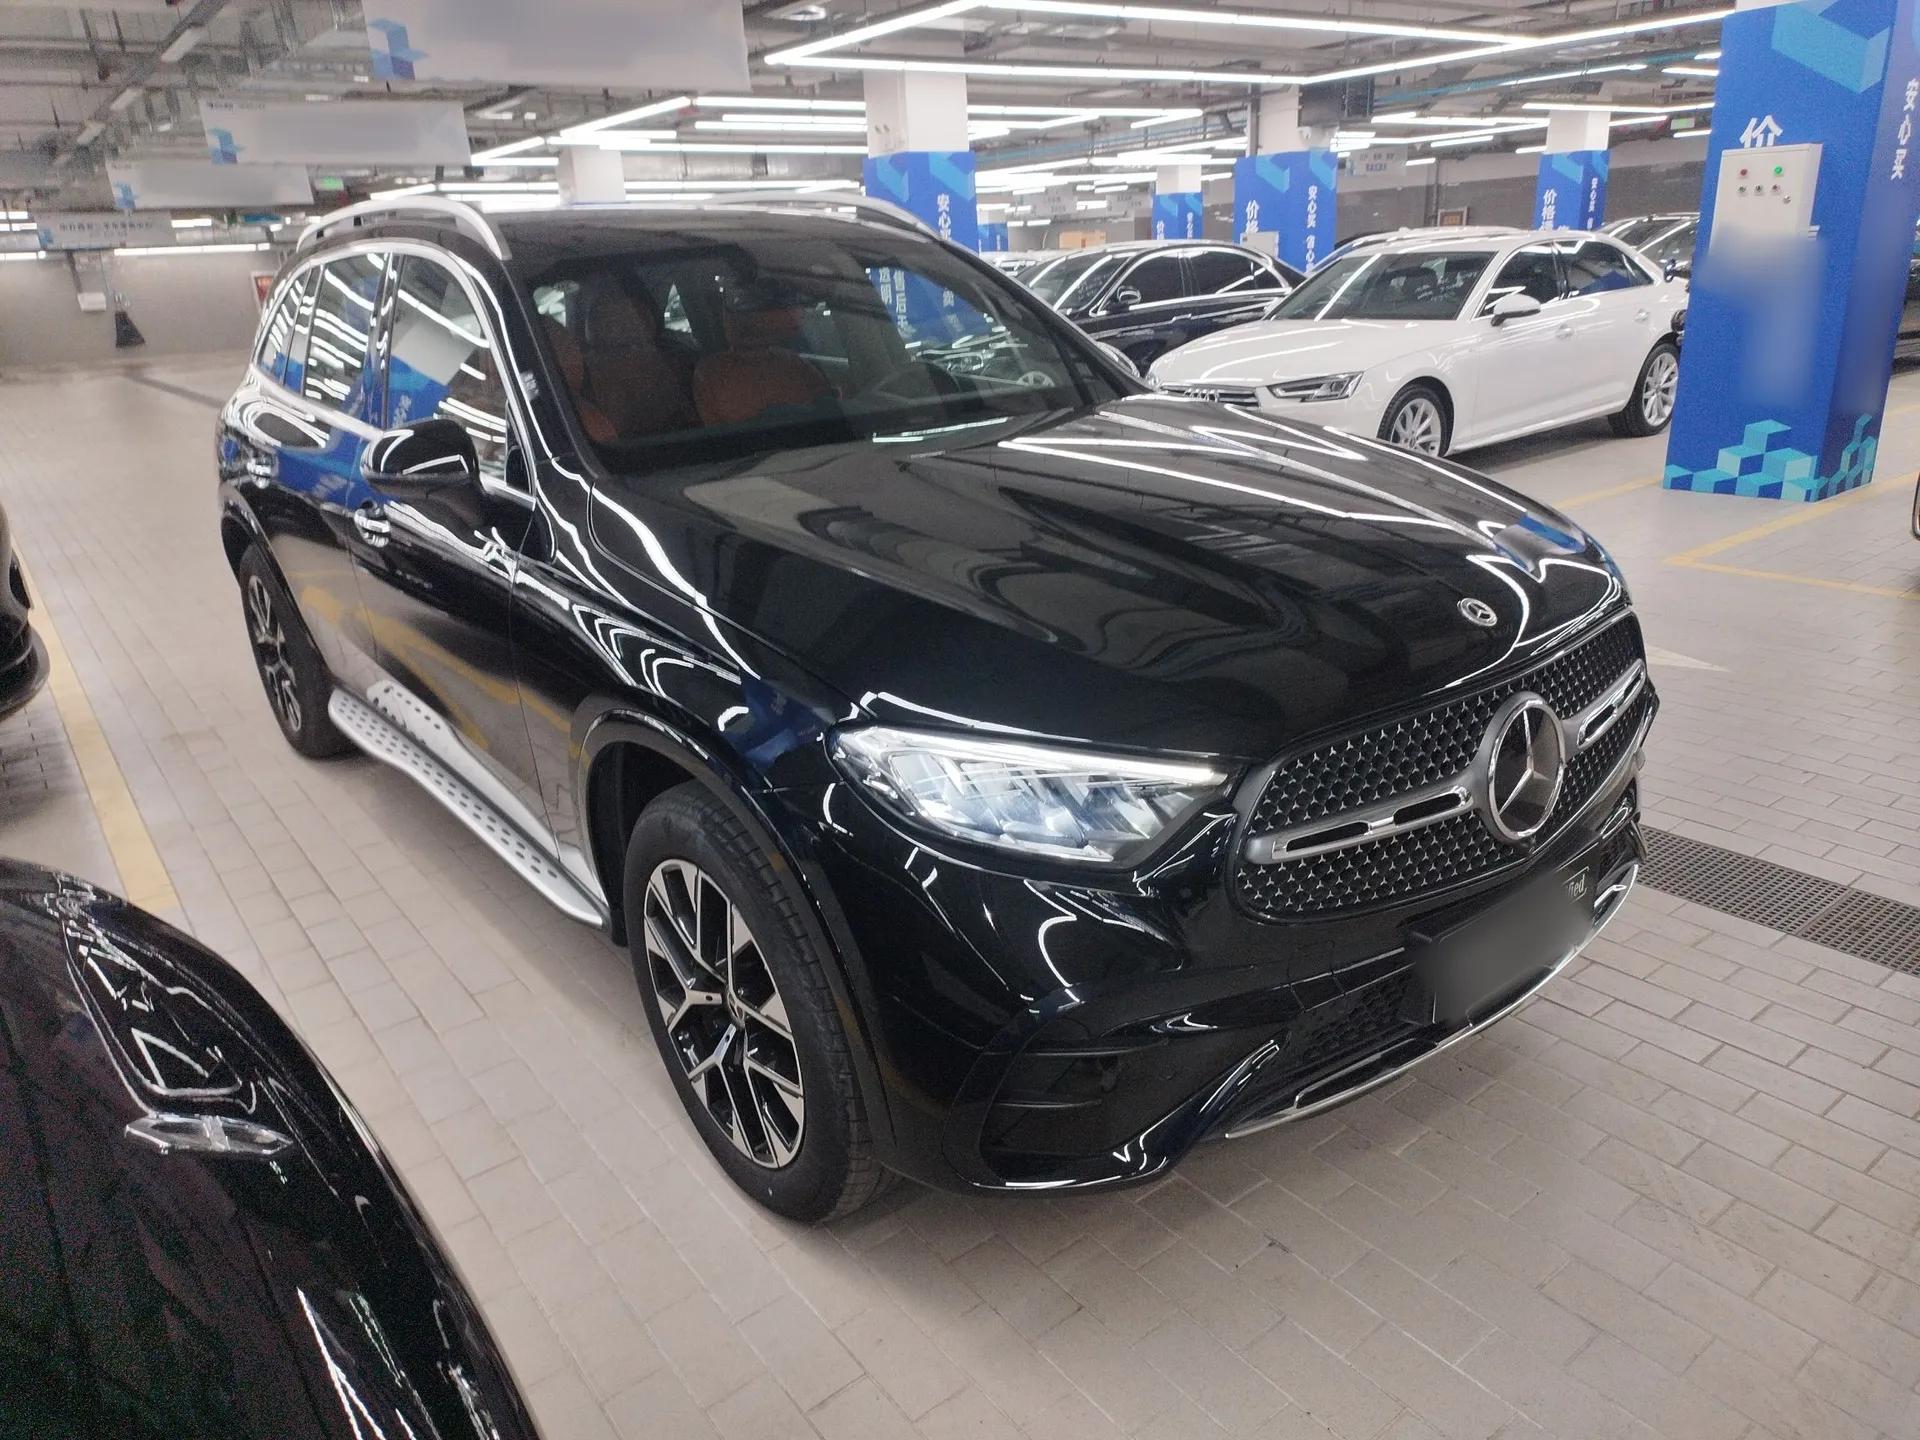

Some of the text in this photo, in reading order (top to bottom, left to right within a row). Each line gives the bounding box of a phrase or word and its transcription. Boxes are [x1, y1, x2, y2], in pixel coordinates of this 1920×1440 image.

[1740, 115, 1783, 148] 价
[1890, 78, 1920, 180] 安心买
[1307, 185, 1318, 228] 安心买
